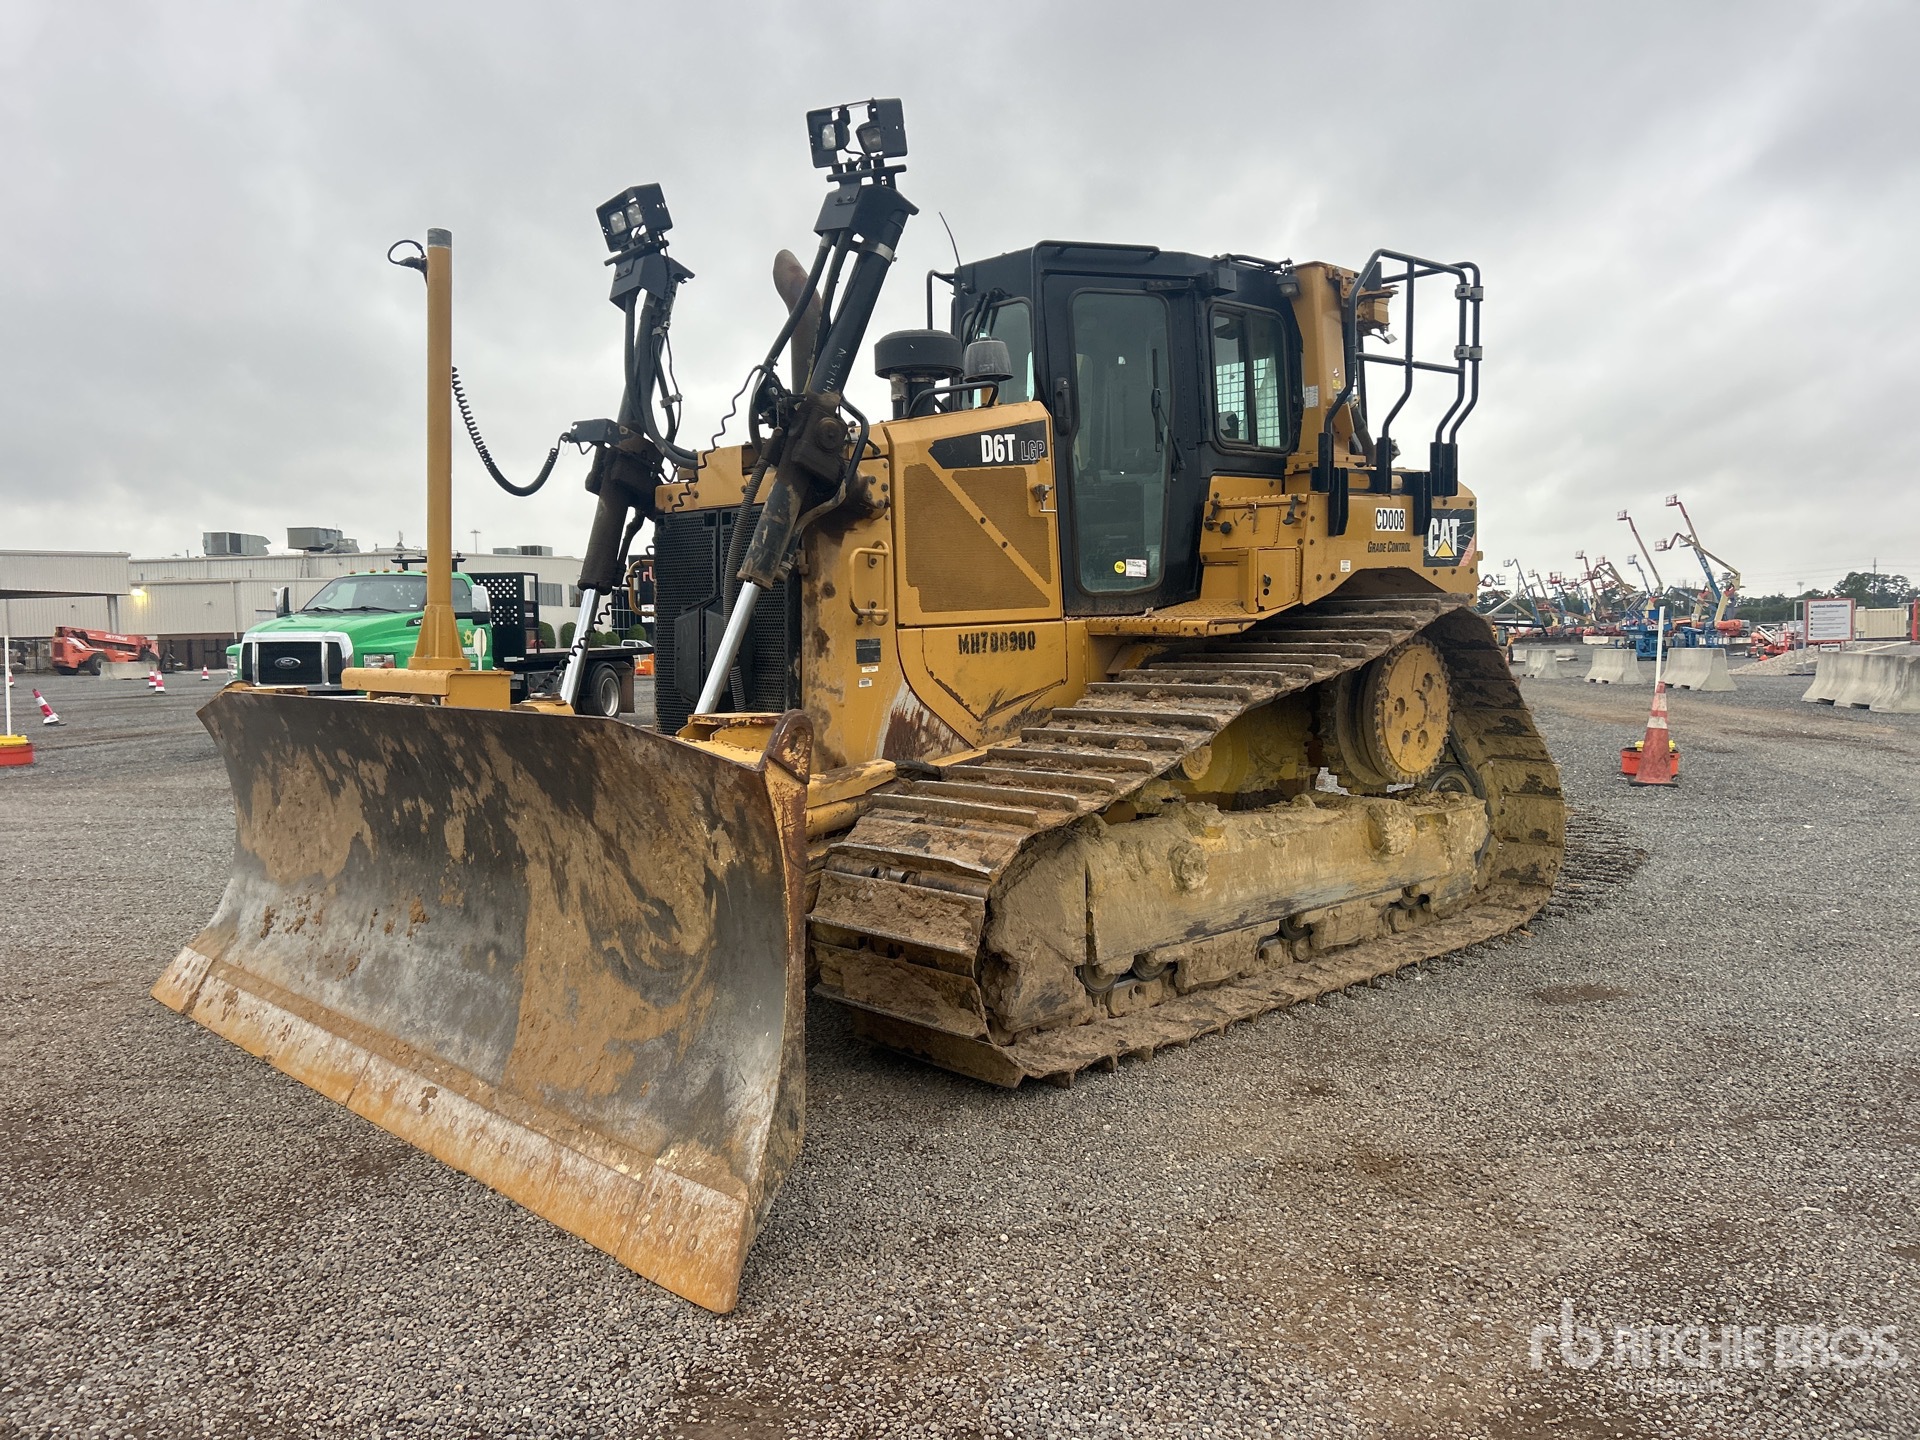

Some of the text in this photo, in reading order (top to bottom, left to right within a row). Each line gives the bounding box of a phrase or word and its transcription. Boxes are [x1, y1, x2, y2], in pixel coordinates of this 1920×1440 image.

[980, 433, 1046, 463] D6T LGP
[1376, 508, 1405, 530] CD008
[1428, 517, 1460, 557] CAT
